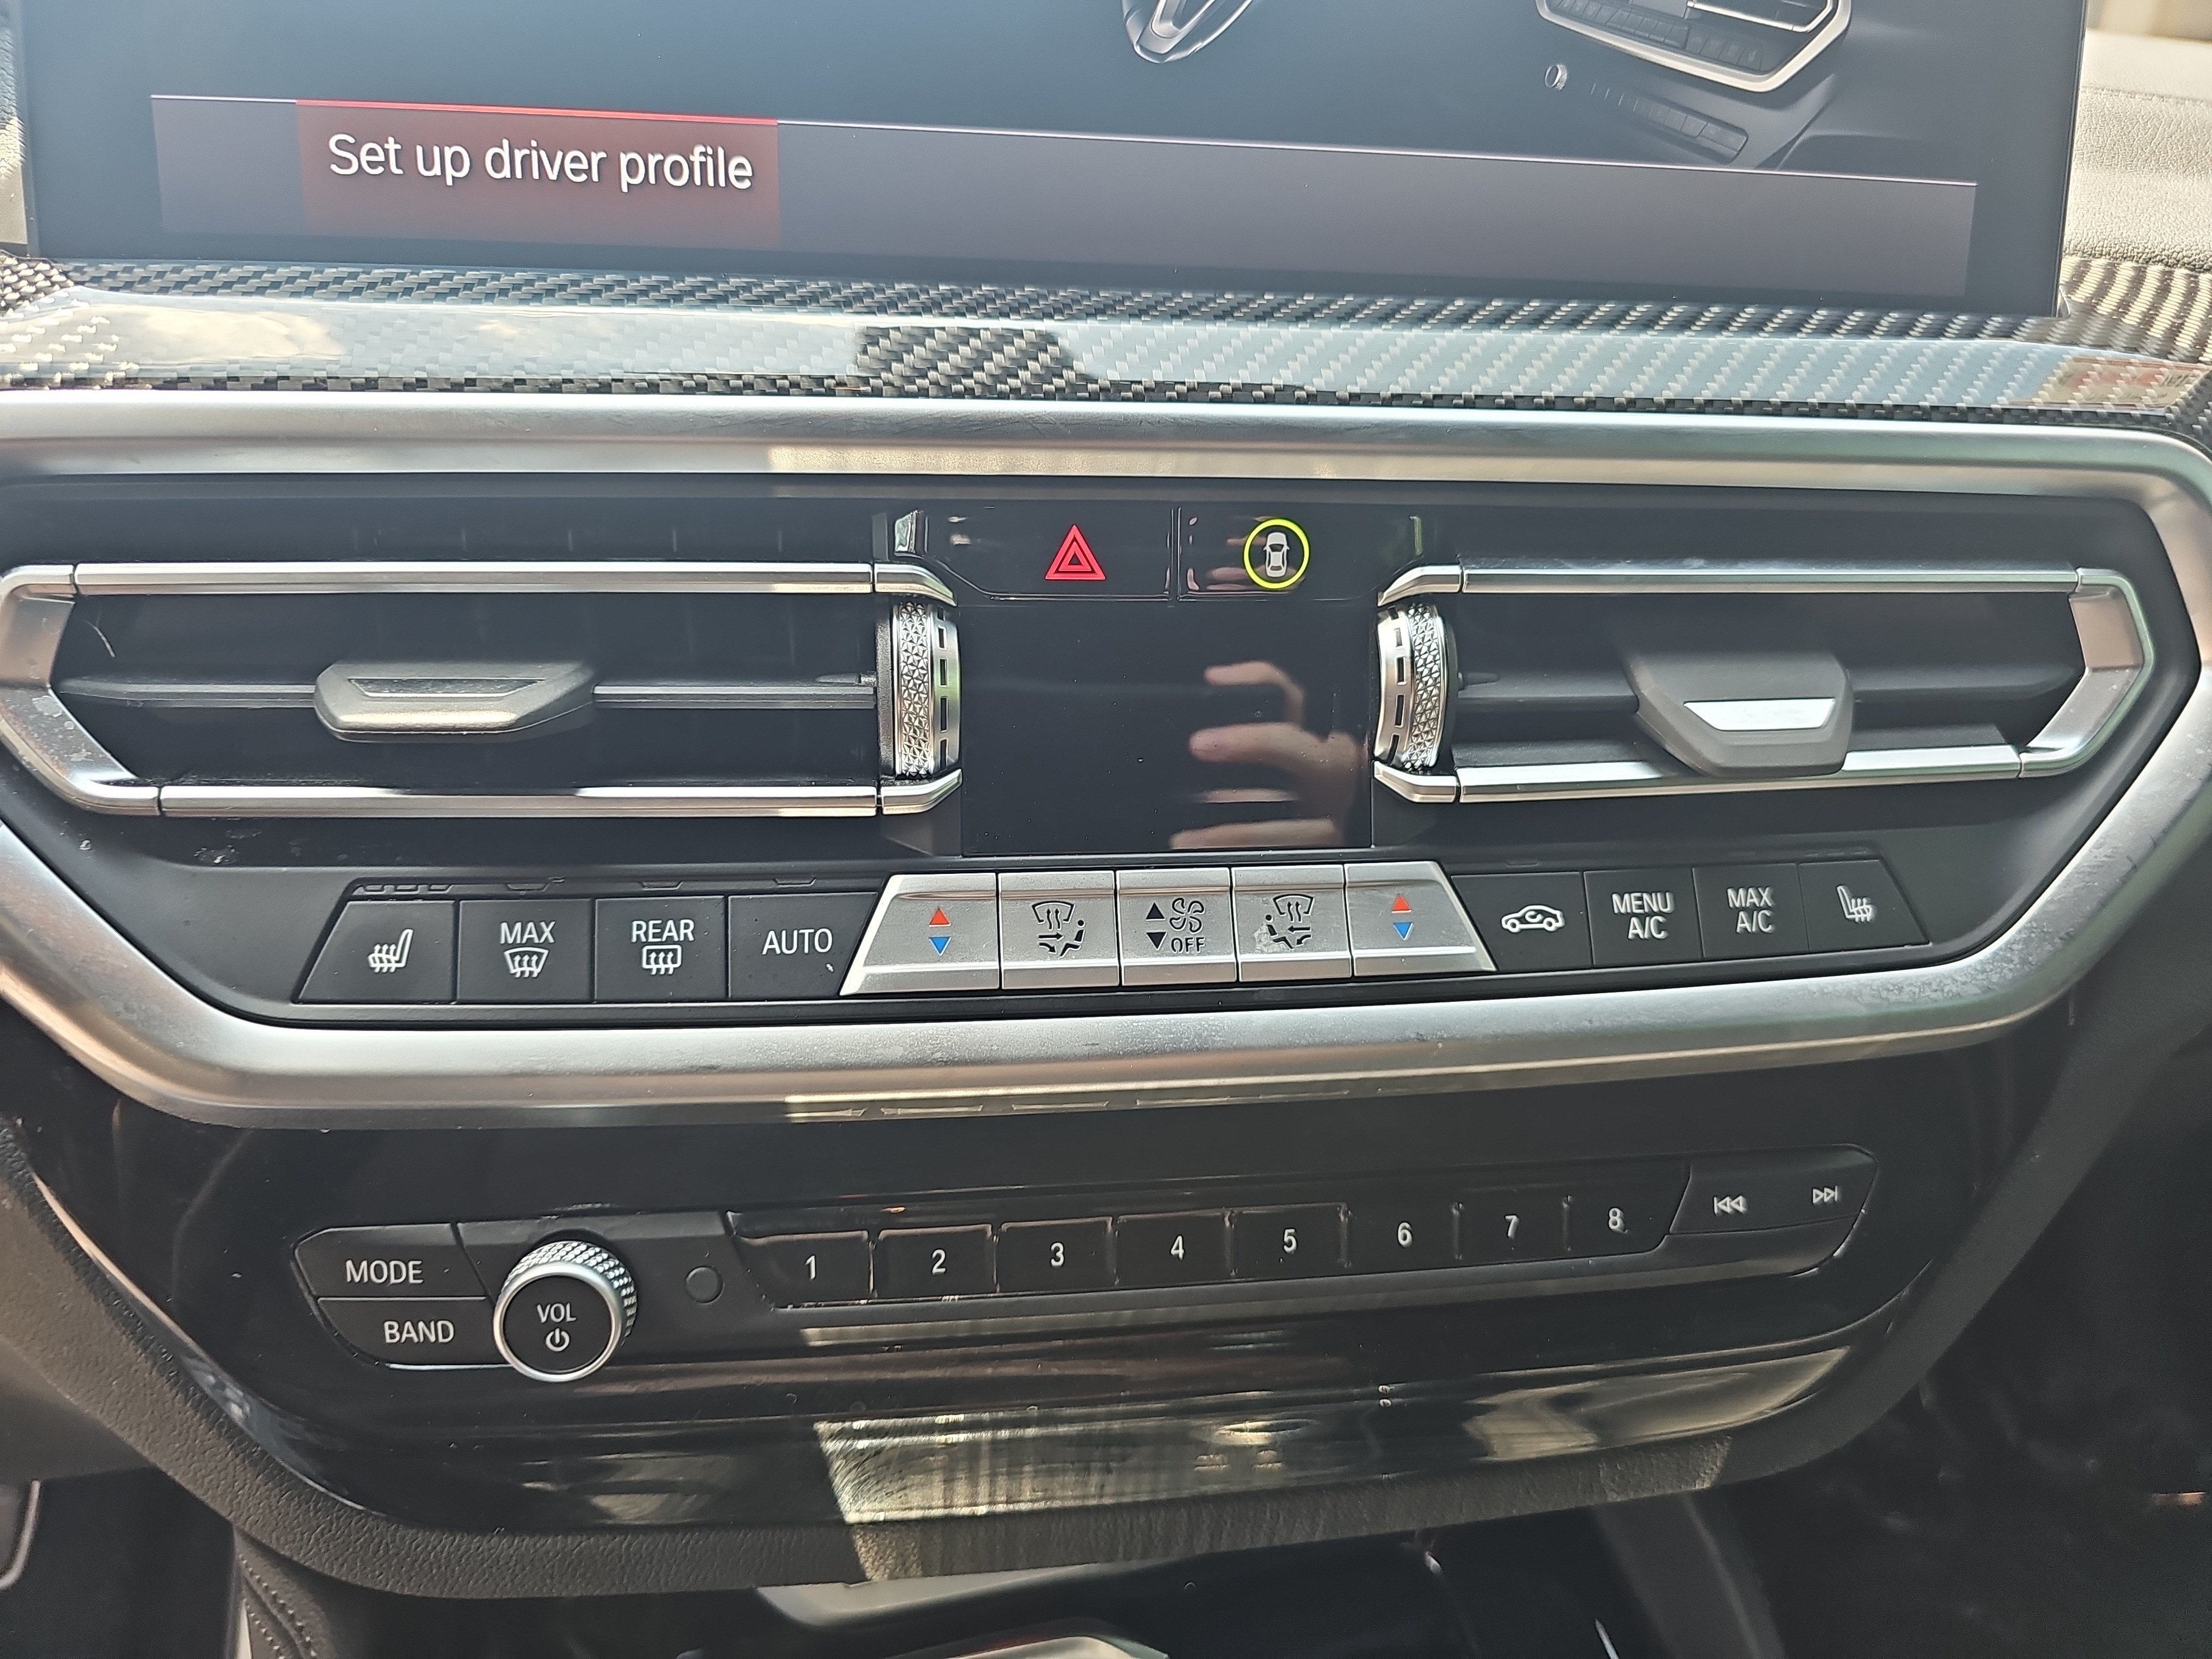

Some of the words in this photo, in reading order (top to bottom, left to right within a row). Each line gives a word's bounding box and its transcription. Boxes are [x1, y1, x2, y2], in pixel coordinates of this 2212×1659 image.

[328, 133, 404, 175] Set
[415, 144, 471, 187] up
[484, 138, 607, 183] driver
[619, 144, 753, 193] profile
[1611, 891, 1673, 915] MENU
[1727, 886, 1773, 909] MAX
[499, 921, 556, 944] MAX
[631, 918, 695, 943] REAR
[1627, 915, 1666, 940] A/C
[1736, 909, 1773, 934] A/C
[761, 928, 833, 955] AUTO
[1171, 936, 1205, 953] OFF
[1504, 1214, 1519, 1238] 7
[1608, 1207, 1623, 1232] 8
[1283, 1228, 1297, 1252] 5
[1397, 1221, 1412, 1246] 6
[1050, 1242, 1065, 1266] 3
[1170, 1235, 1185, 1260] 4
[345, 1259, 424, 1285] MODE
[805, 1255, 816, 1280] 1
[931, 1249, 947, 1274] 2
[536, 1302, 577, 1323] VOL
[383, 1320, 454, 1343] BAND
